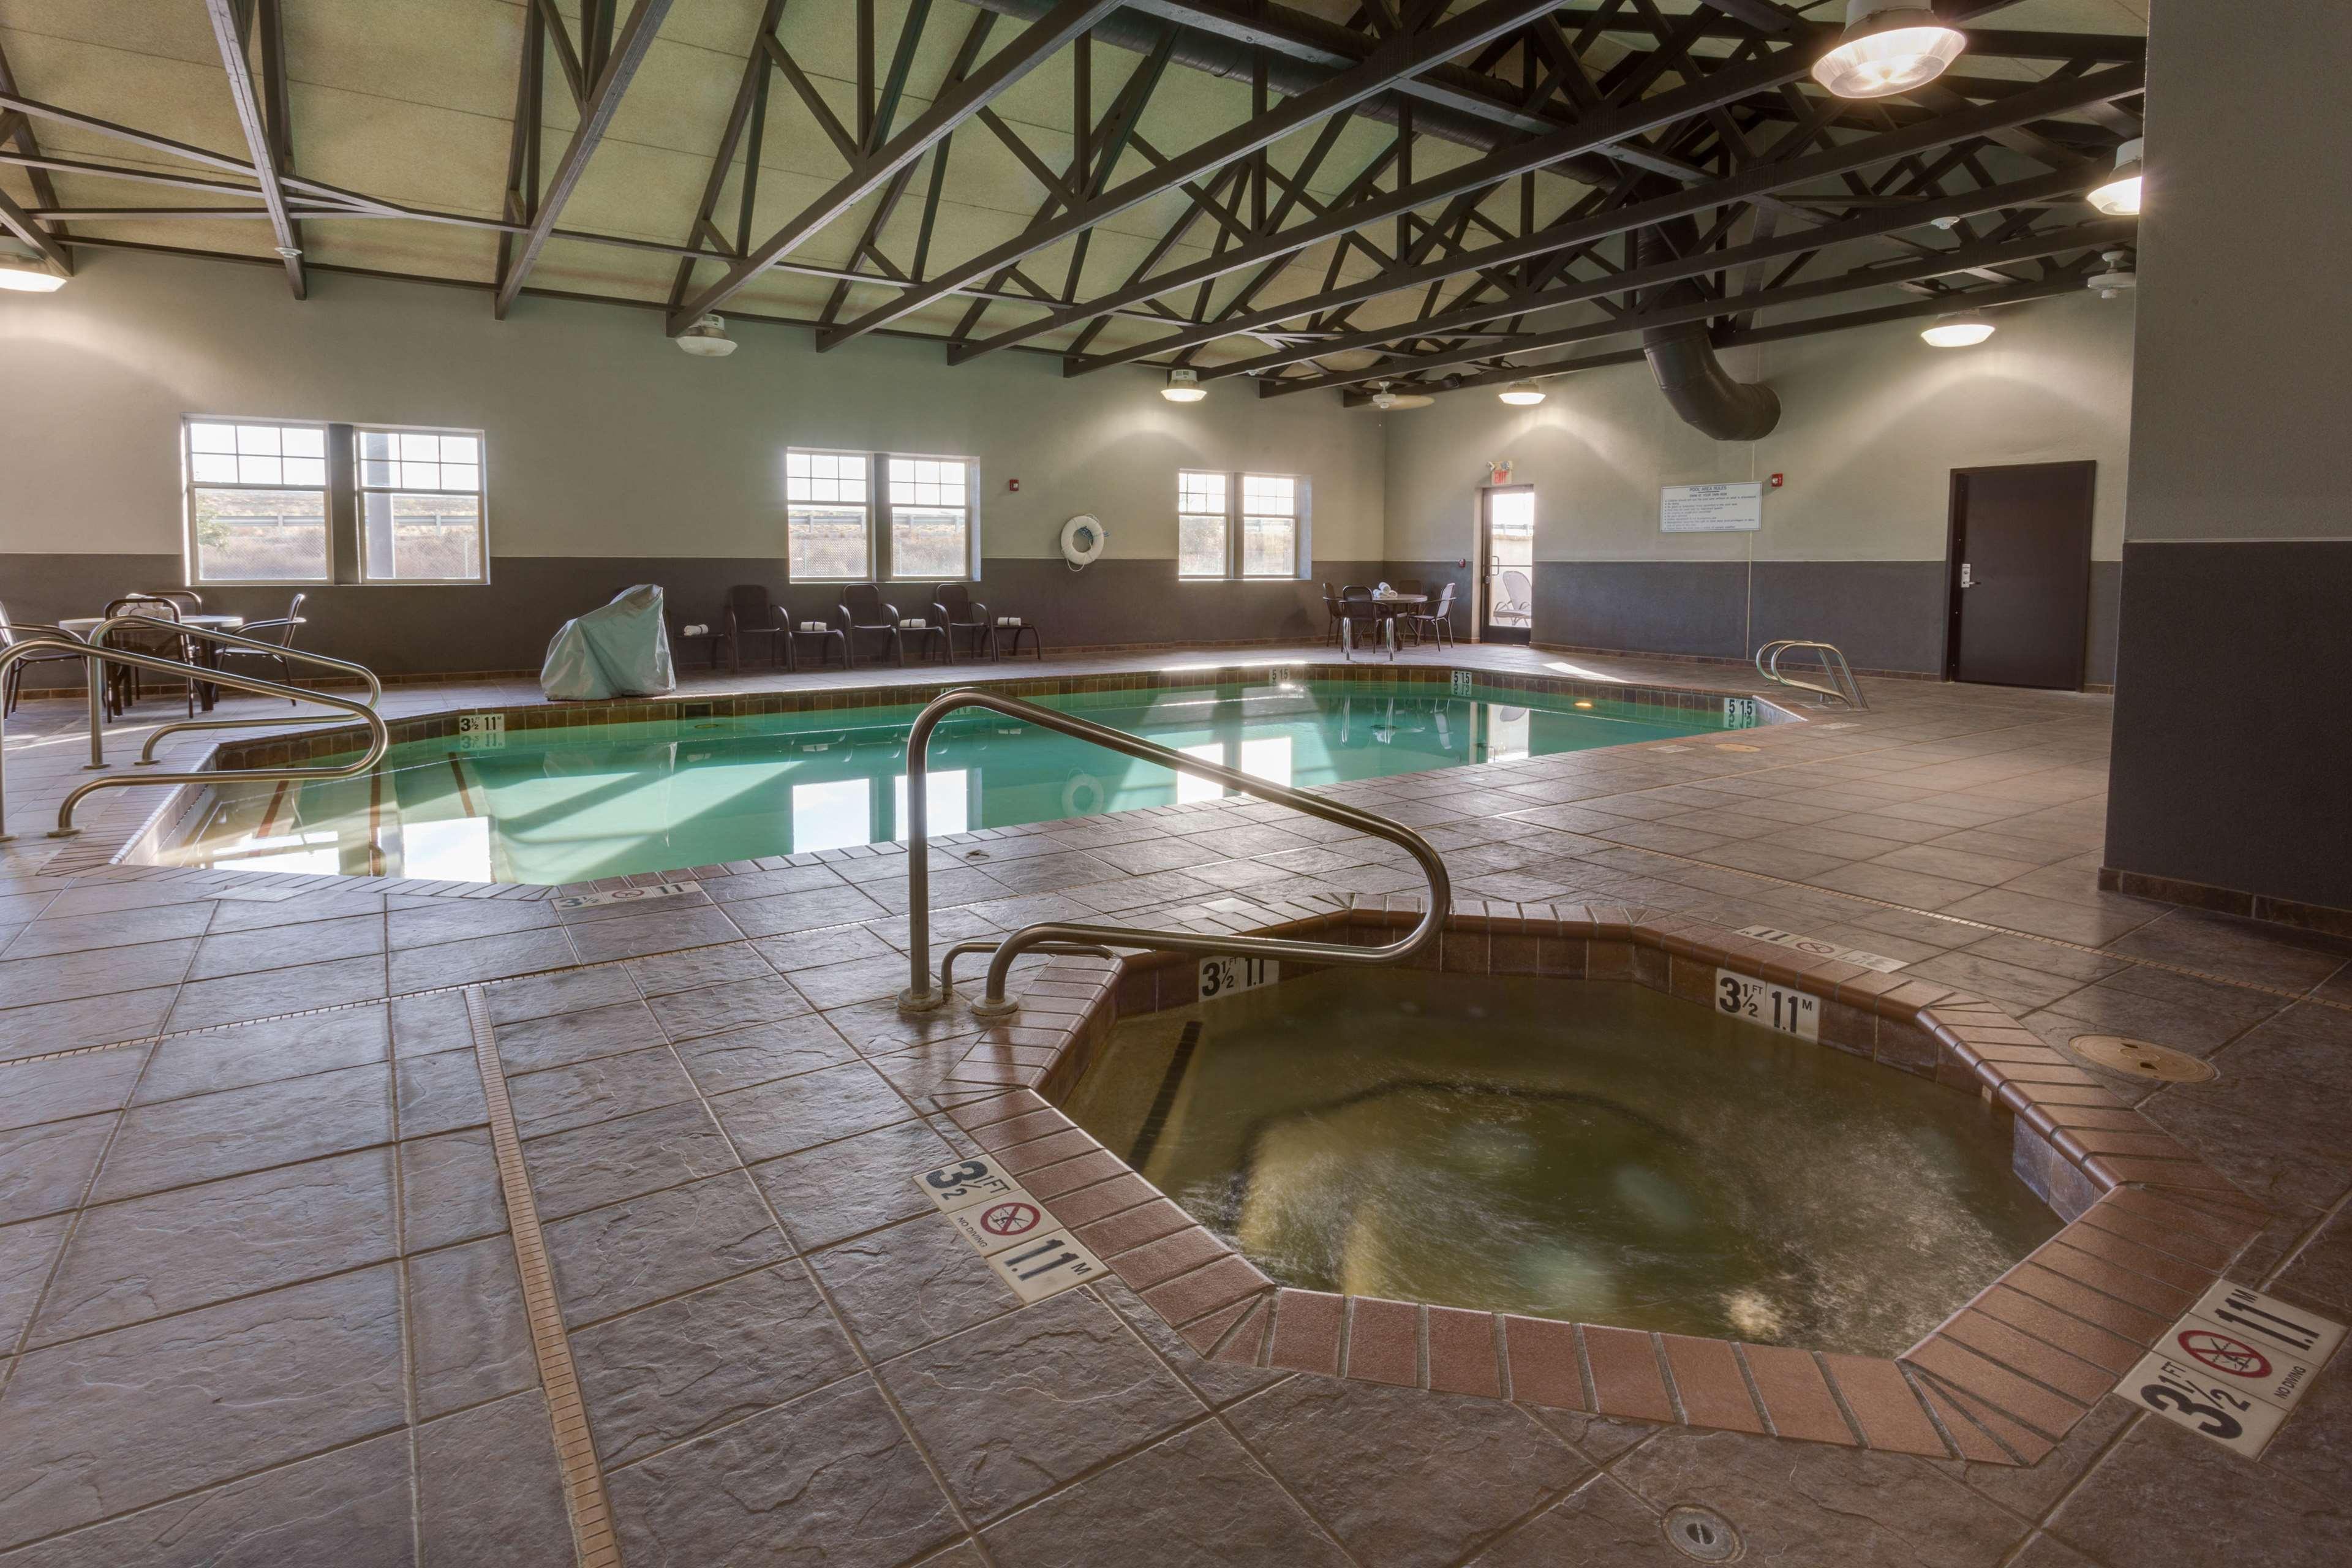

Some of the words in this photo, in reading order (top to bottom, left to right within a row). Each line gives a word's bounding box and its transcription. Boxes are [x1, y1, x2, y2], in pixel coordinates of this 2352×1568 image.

[1454, 671, 1458, 683] 5
[1729, 699, 1735, 714] 5
[1740, 700, 1752, 715] 1.5
[1752, 984, 1763, 995] FT
[1771, 990, 1798, 1034] 1.1
[1802, 998, 1812, 1011] M
[983, 1176, 1011, 1194] FT
[956, 1216, 970, 1227] NO
[965, 1226, 988, 1248] DIVING
[1004, 1238, 1080, 1282] 1.1
[1070, 1262, 1093, 1276] M
[2231, 1288, 2258, 1303] M
[2214, 1297, 2320, 1351] 1.1
[2160, 1360, 2187, 1379] FT
[2273, 1384, 2290, 1400] NO
[2283, 1365, 2307, 1391] DIVING
